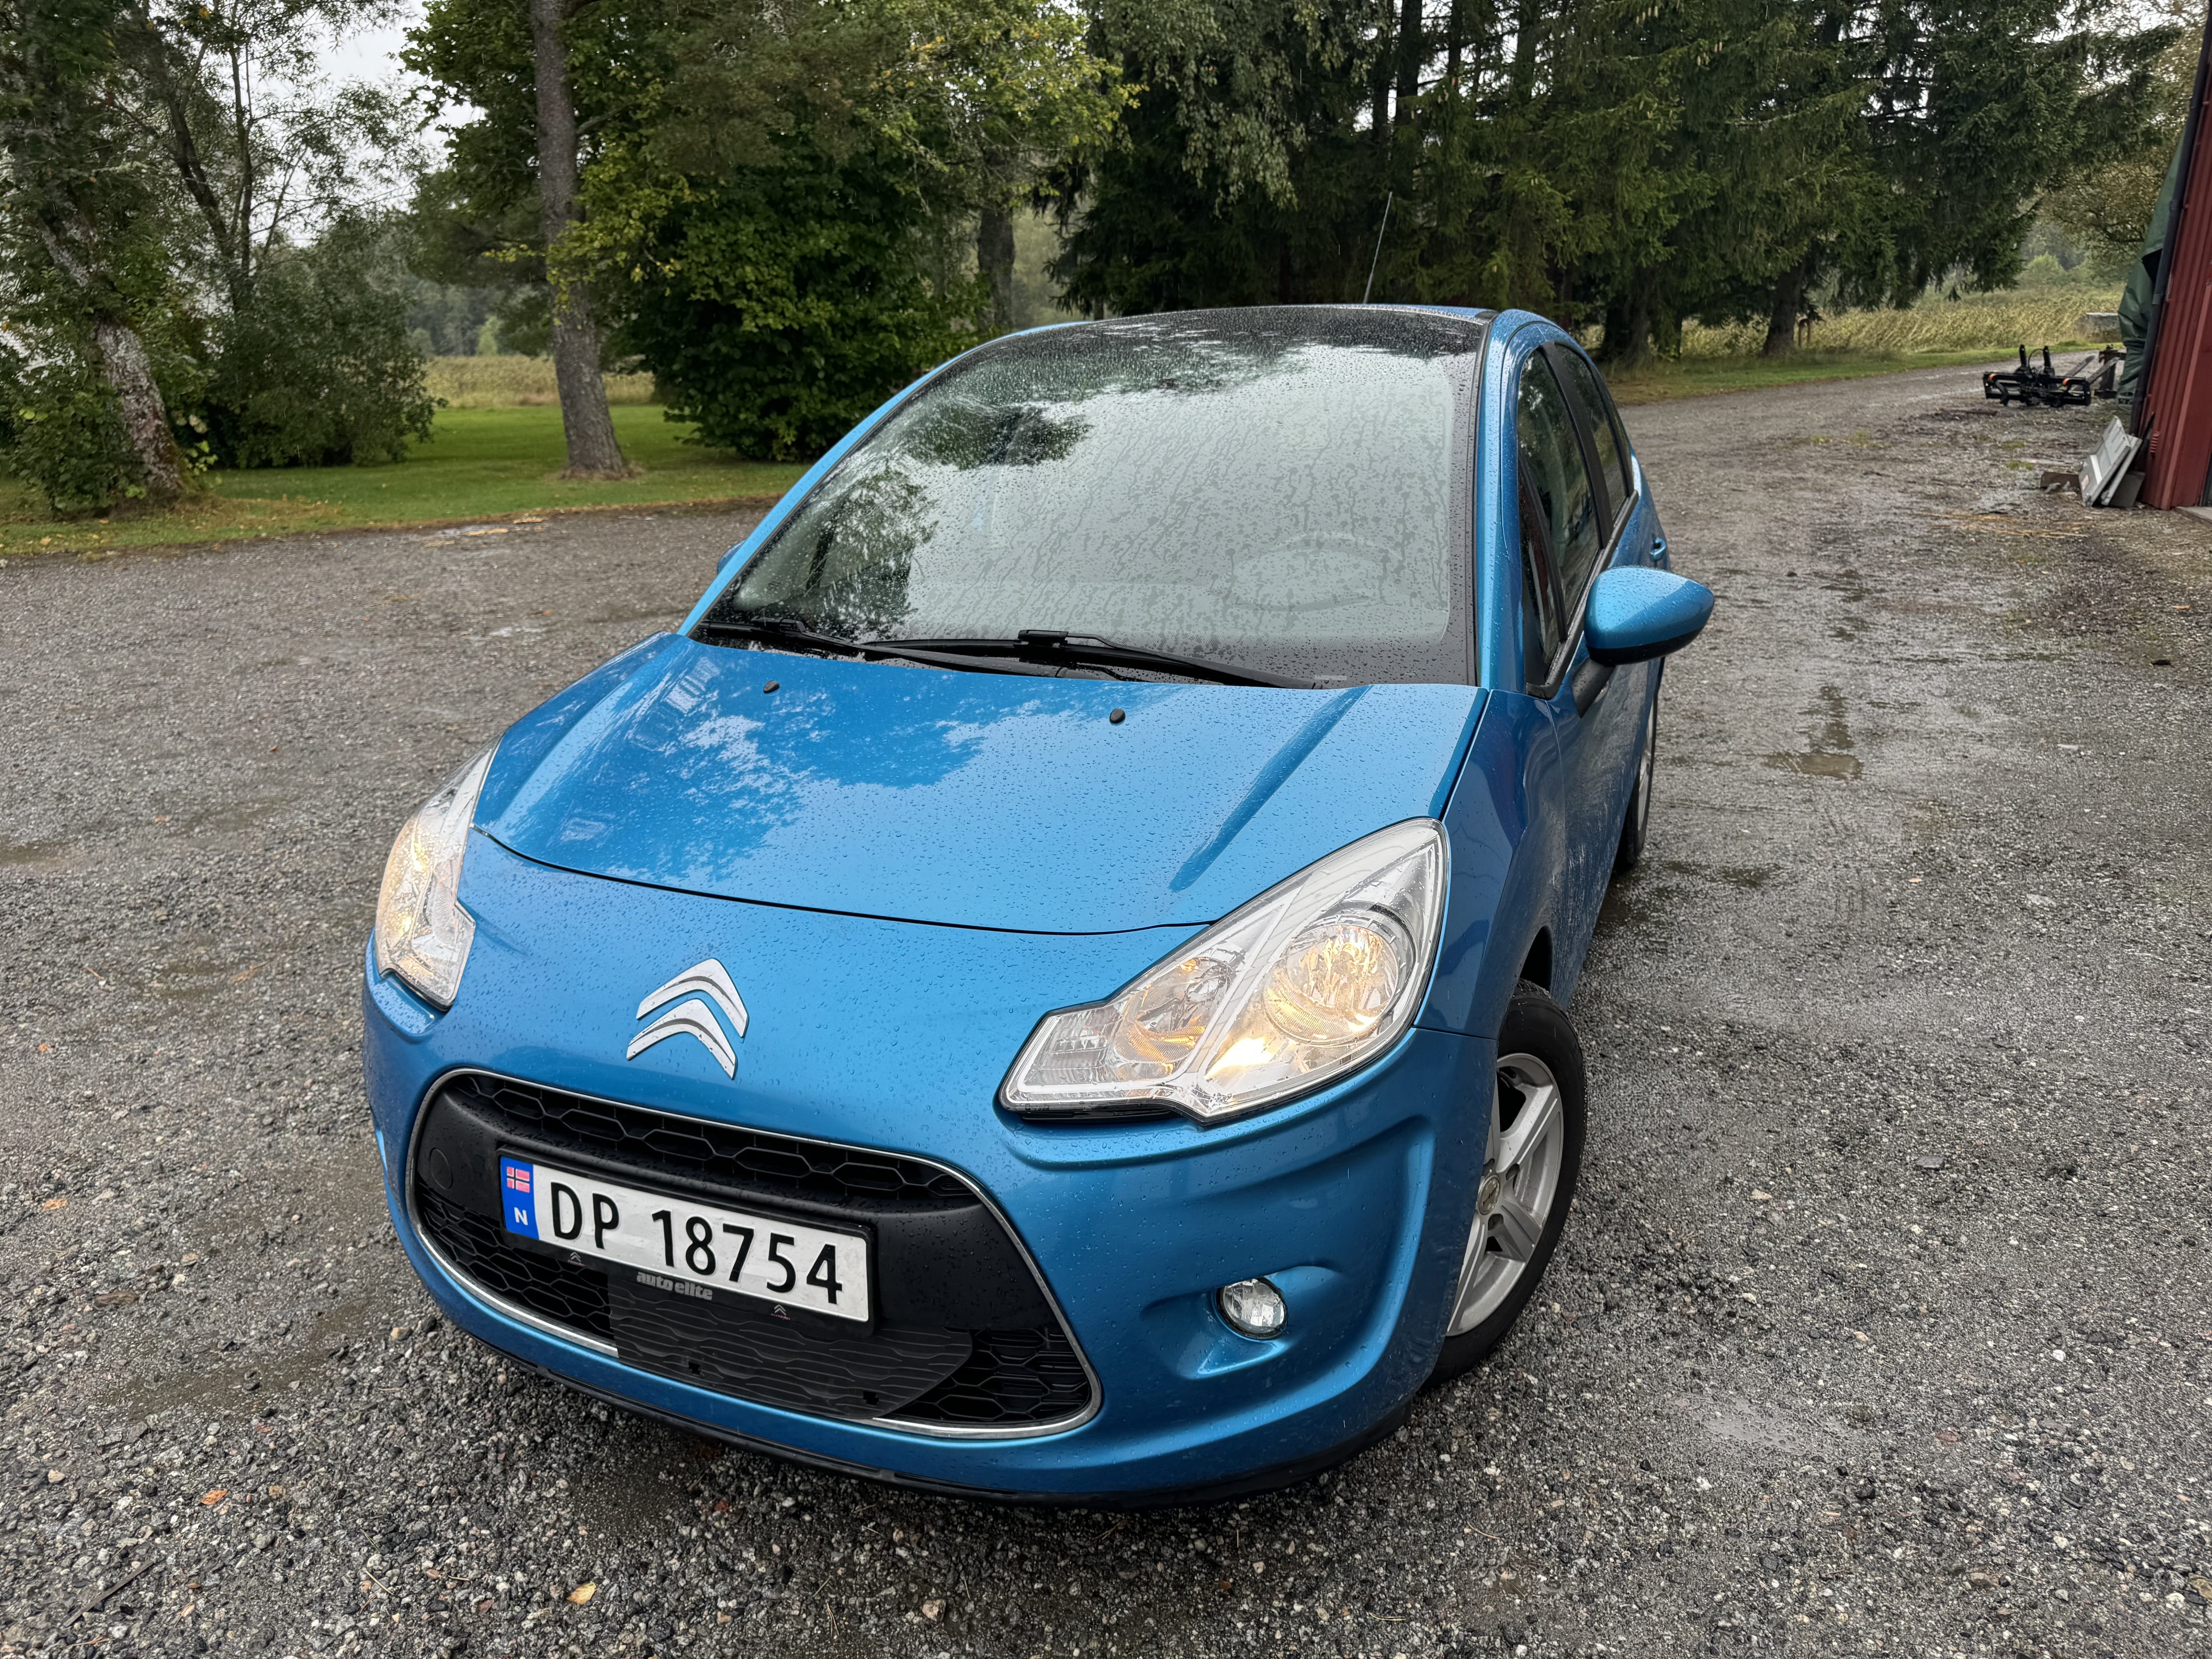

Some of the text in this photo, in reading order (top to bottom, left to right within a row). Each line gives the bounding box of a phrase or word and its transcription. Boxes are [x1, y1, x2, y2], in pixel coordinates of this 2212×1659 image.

[514, 1207, 528, 1226] N
[551, 1182, 842, 1304] DP 18754
[637, 1271, 713, 1300] auto elite
